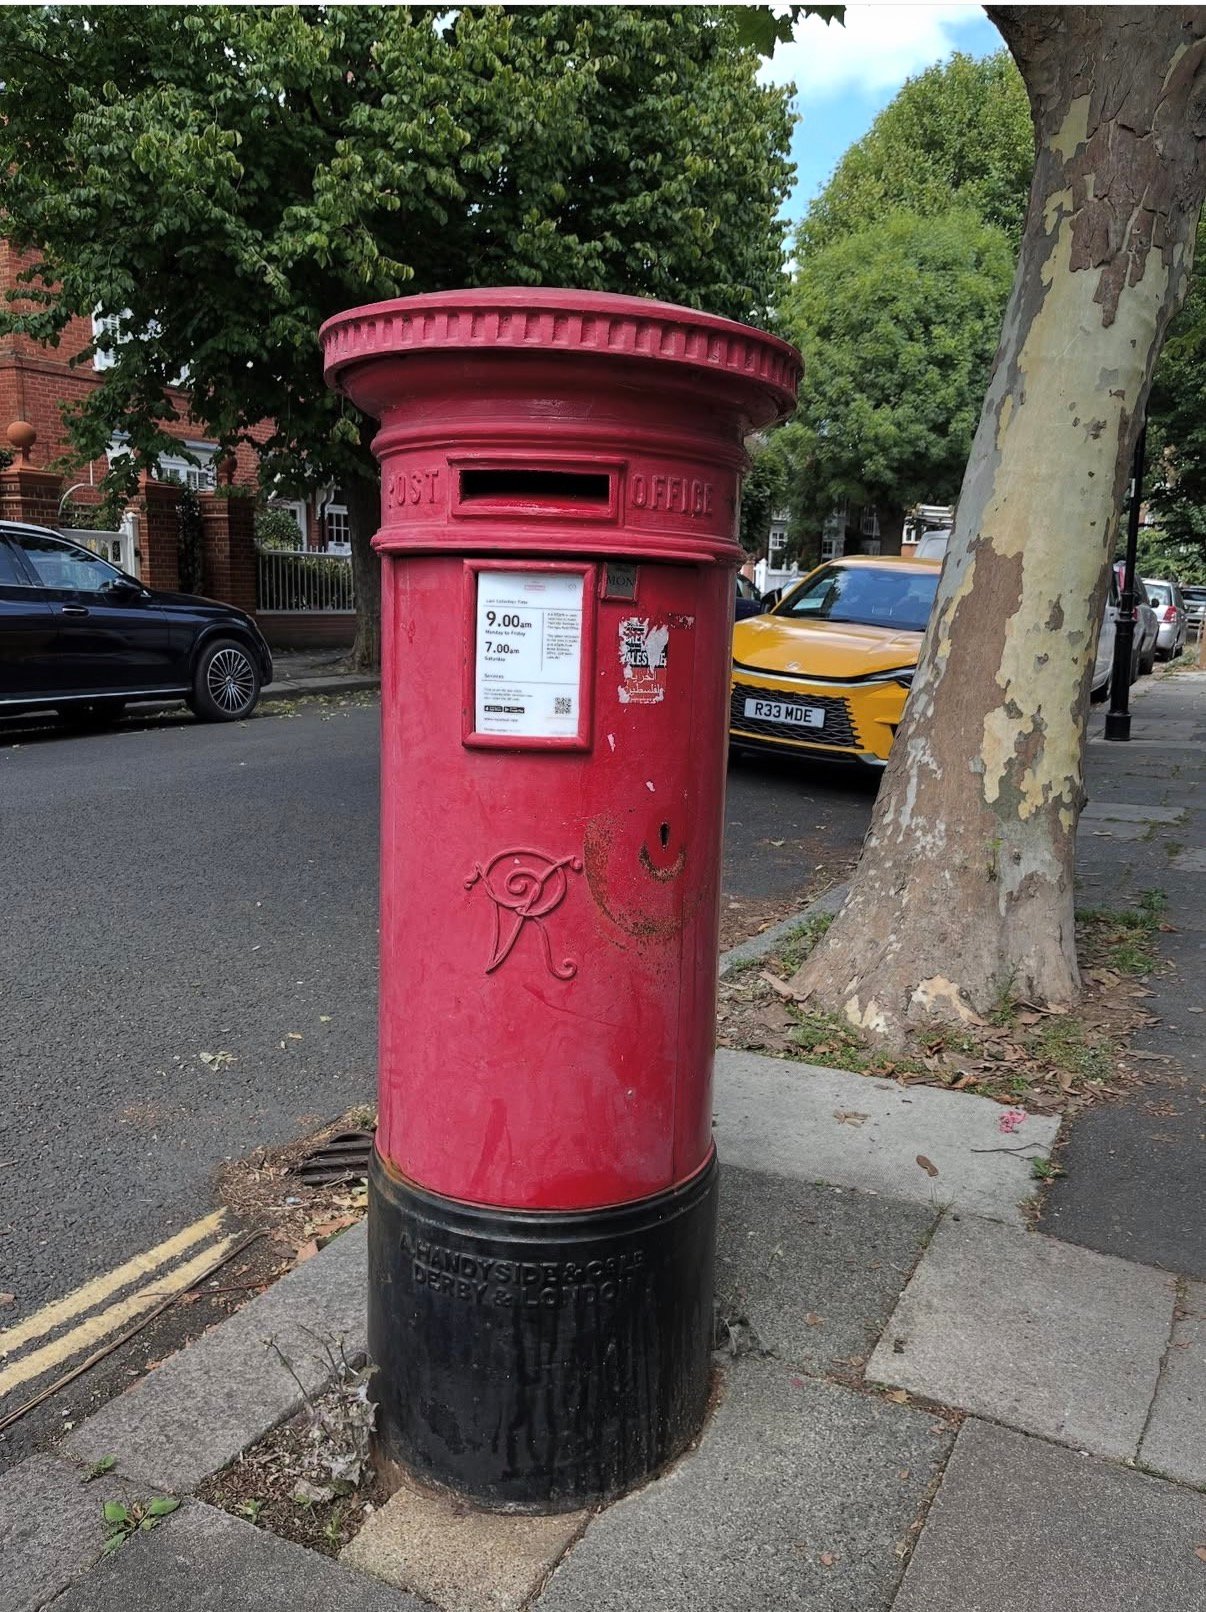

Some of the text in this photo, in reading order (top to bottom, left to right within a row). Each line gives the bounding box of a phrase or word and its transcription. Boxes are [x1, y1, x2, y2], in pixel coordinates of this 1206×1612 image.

[387, 469, 439, 509] POST
[631, 474, 713, 515] OFFICE
[607, 576, 635, 587] MON
[486, 611, 532, 628] 9.00am
[485, 641, 520, 654] 7.00am
[755, 702, 812, 723] R33 MDE
[412, 1259, 486, 1304] DERBY
[493, 1287, 512, 1308] &
